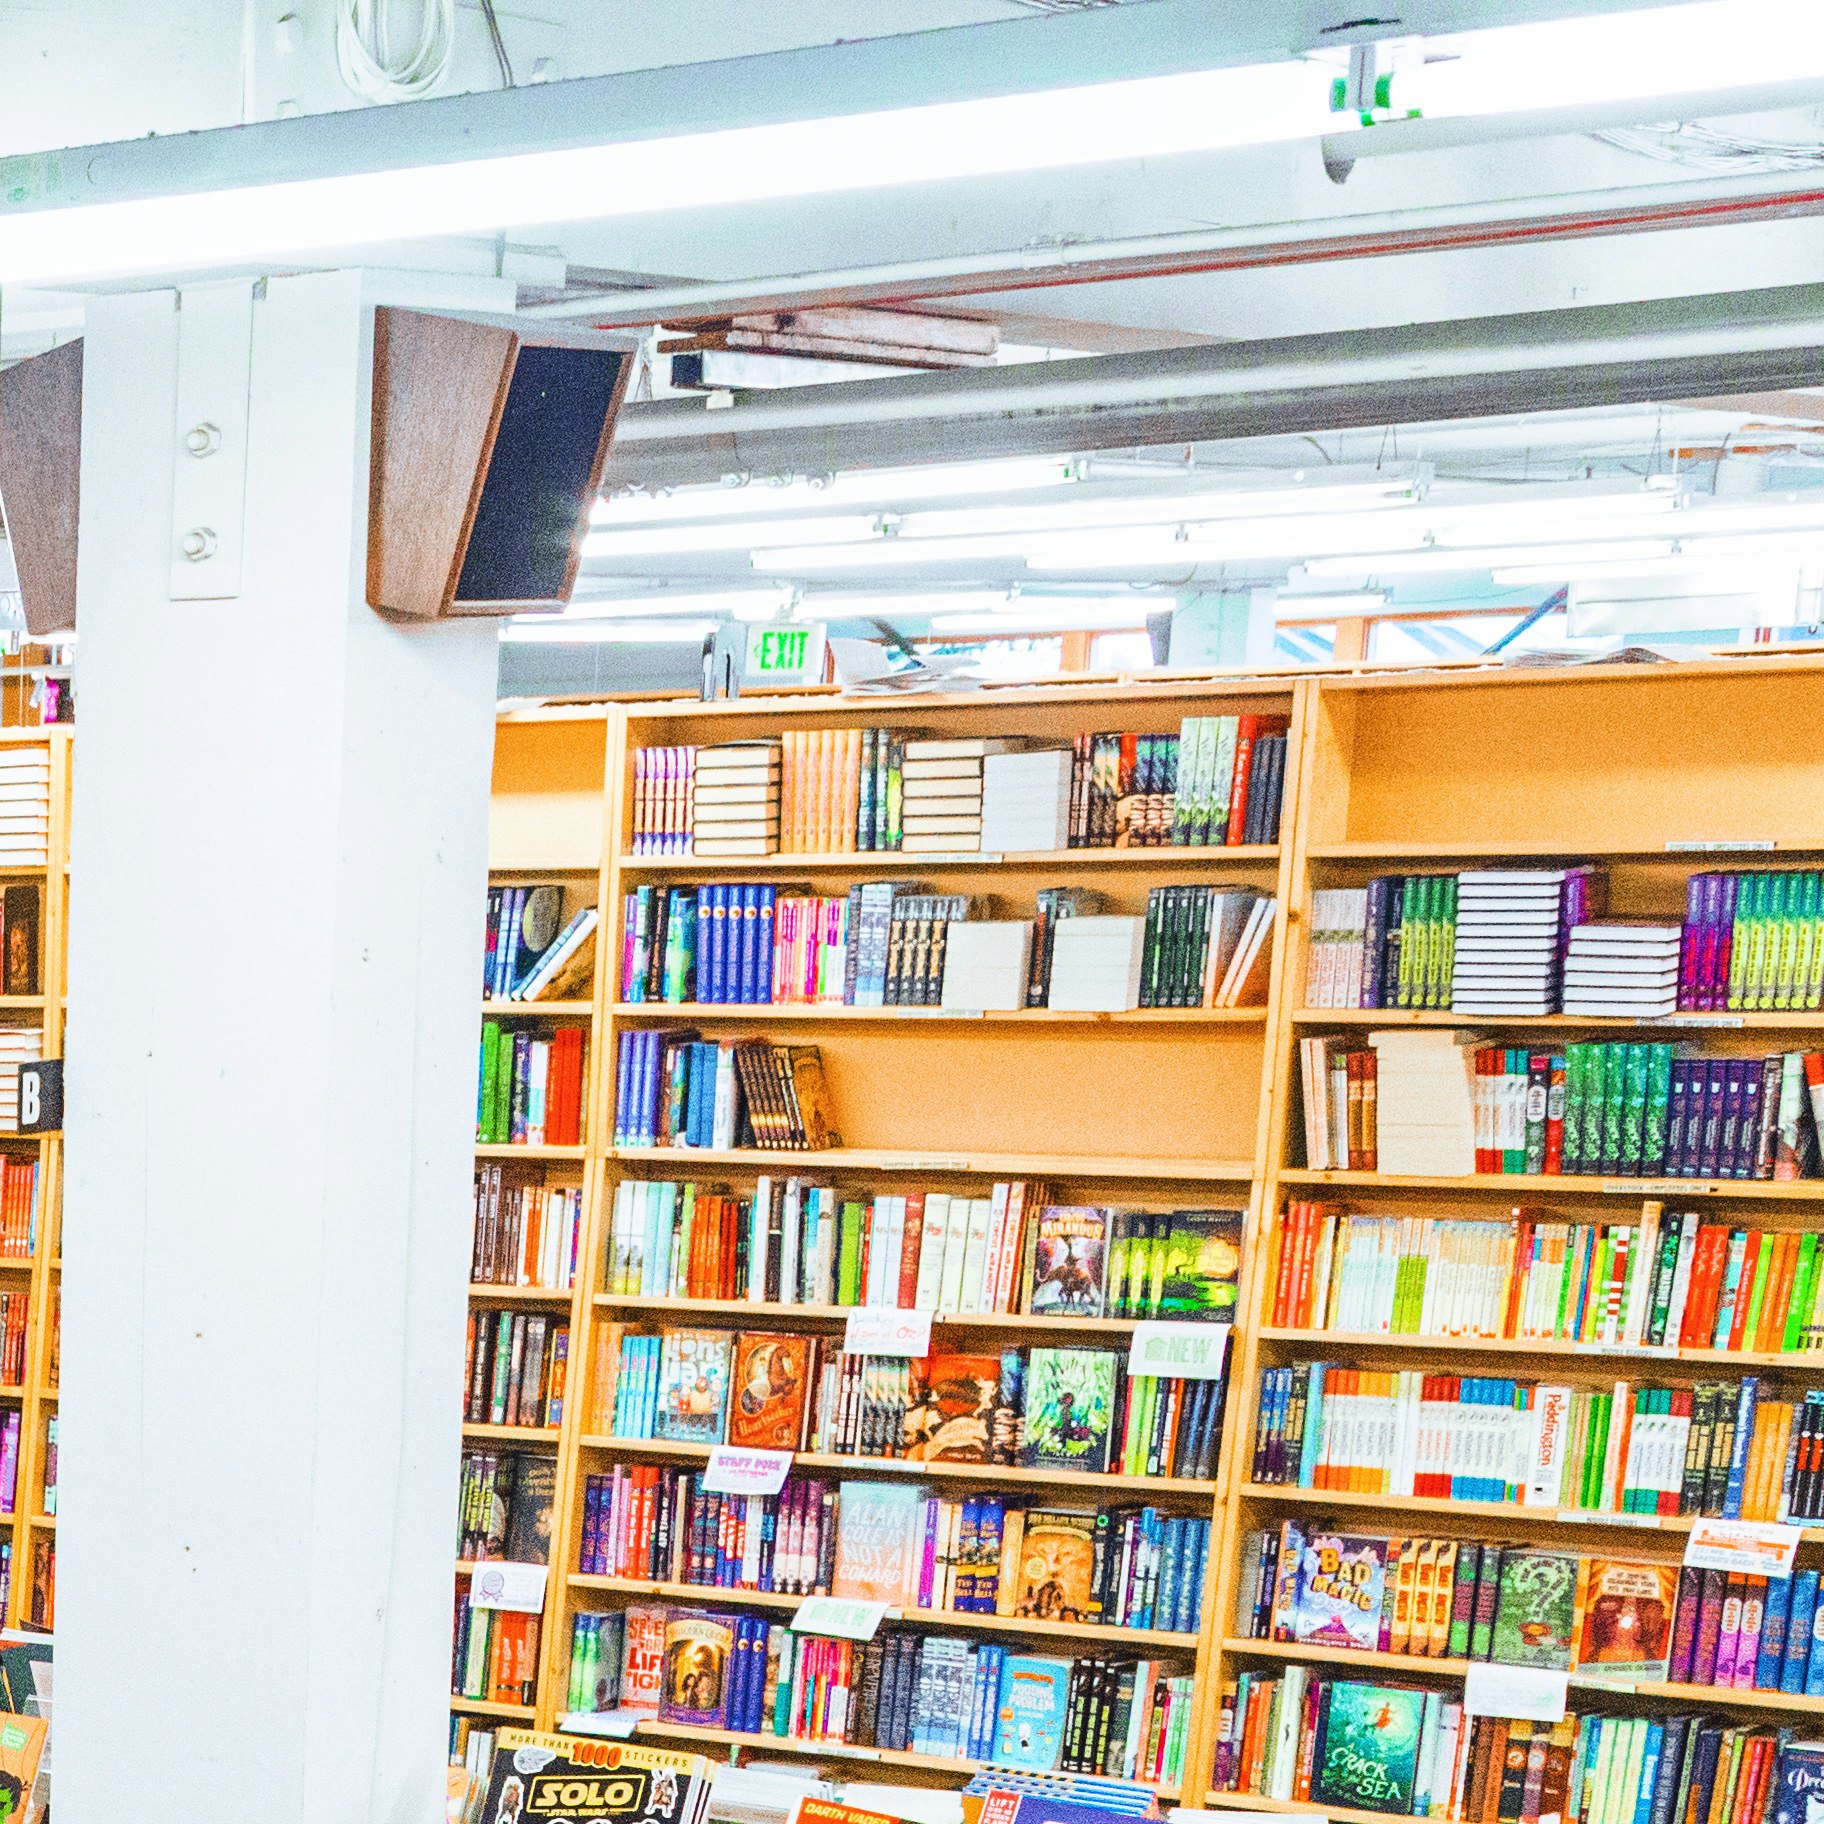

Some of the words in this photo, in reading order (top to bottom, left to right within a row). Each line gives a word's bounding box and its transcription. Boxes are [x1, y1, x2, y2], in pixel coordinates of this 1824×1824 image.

[760, 628, 809, 672] EXIT
[21, 1072, 42, 1125] B
[1320, 1548, 1373, 1585] BAD
[535, 1778, 637, 1813] SOLO
[1355, 1779, 1402, 1800] SEA
